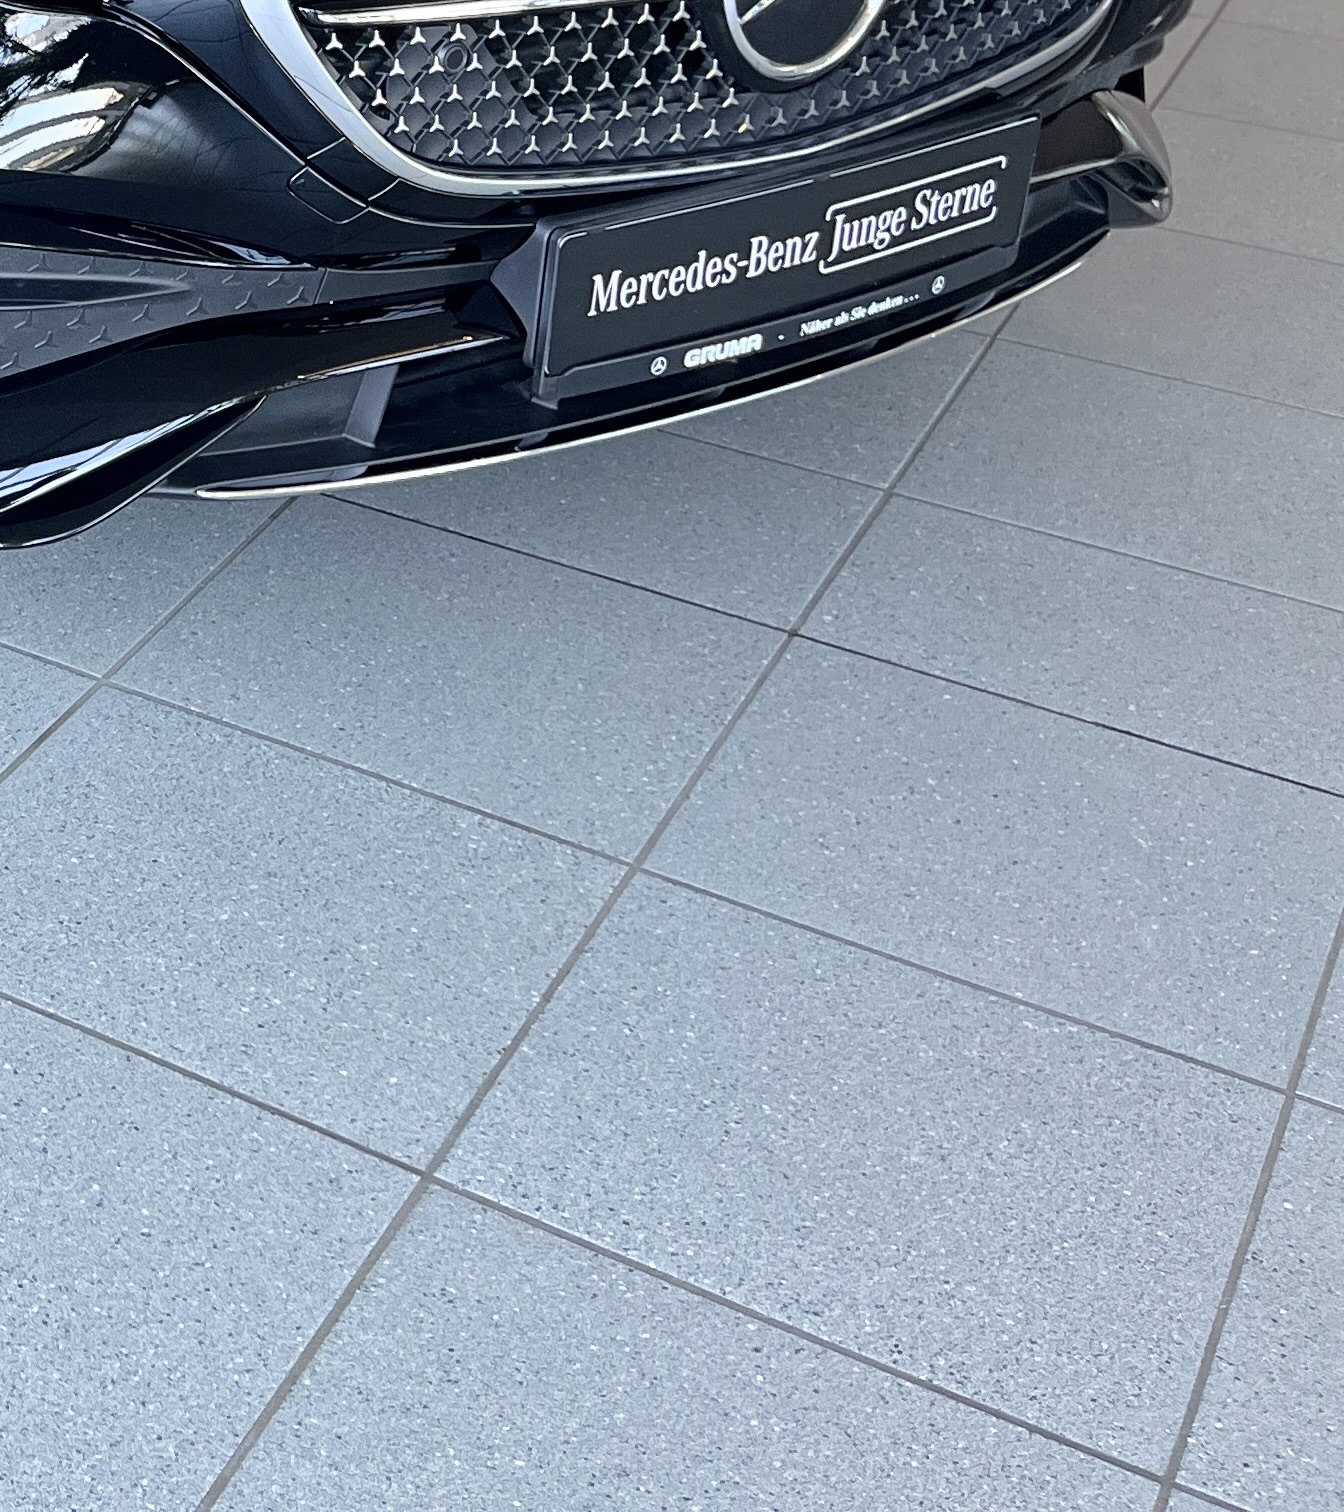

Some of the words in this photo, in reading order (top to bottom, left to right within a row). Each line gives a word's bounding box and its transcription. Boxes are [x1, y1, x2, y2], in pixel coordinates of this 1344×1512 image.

[587, 232, 820, 316] Mercedes-Benz
[826, 210, 905, 262] Junge
[911, 178, 996, 230] Sterne
[683, 333, 763, 368] GRUMA
